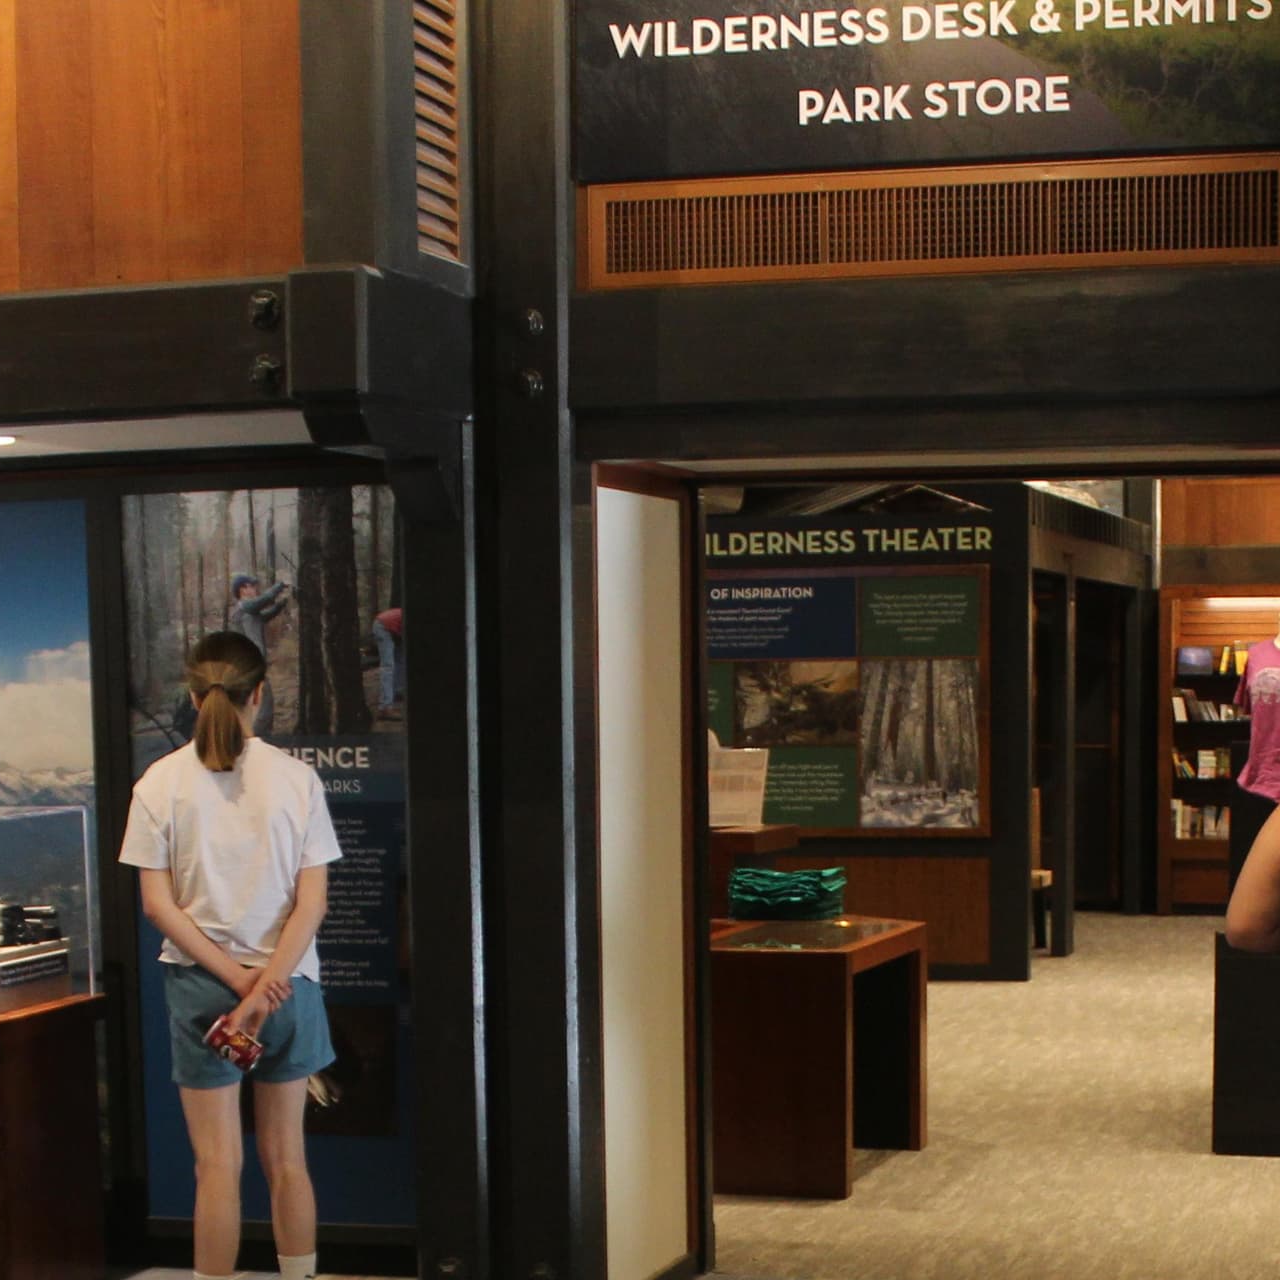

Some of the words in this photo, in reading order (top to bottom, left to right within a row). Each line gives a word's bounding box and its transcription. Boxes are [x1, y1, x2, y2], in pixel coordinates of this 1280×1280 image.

[608, 8, 889, 59] WILDERNESS
[902, 0, 1018, 41] DESK
[1029, 0, 1061, 33] &
[799, 84, 912, 126] PARK
[923, 75, 1070, 119] STORE
[862, 526, 992, 551] THEATER
[710, 587, 729, 600] OF
[732, 586, 813, 600] INSPIRATION
